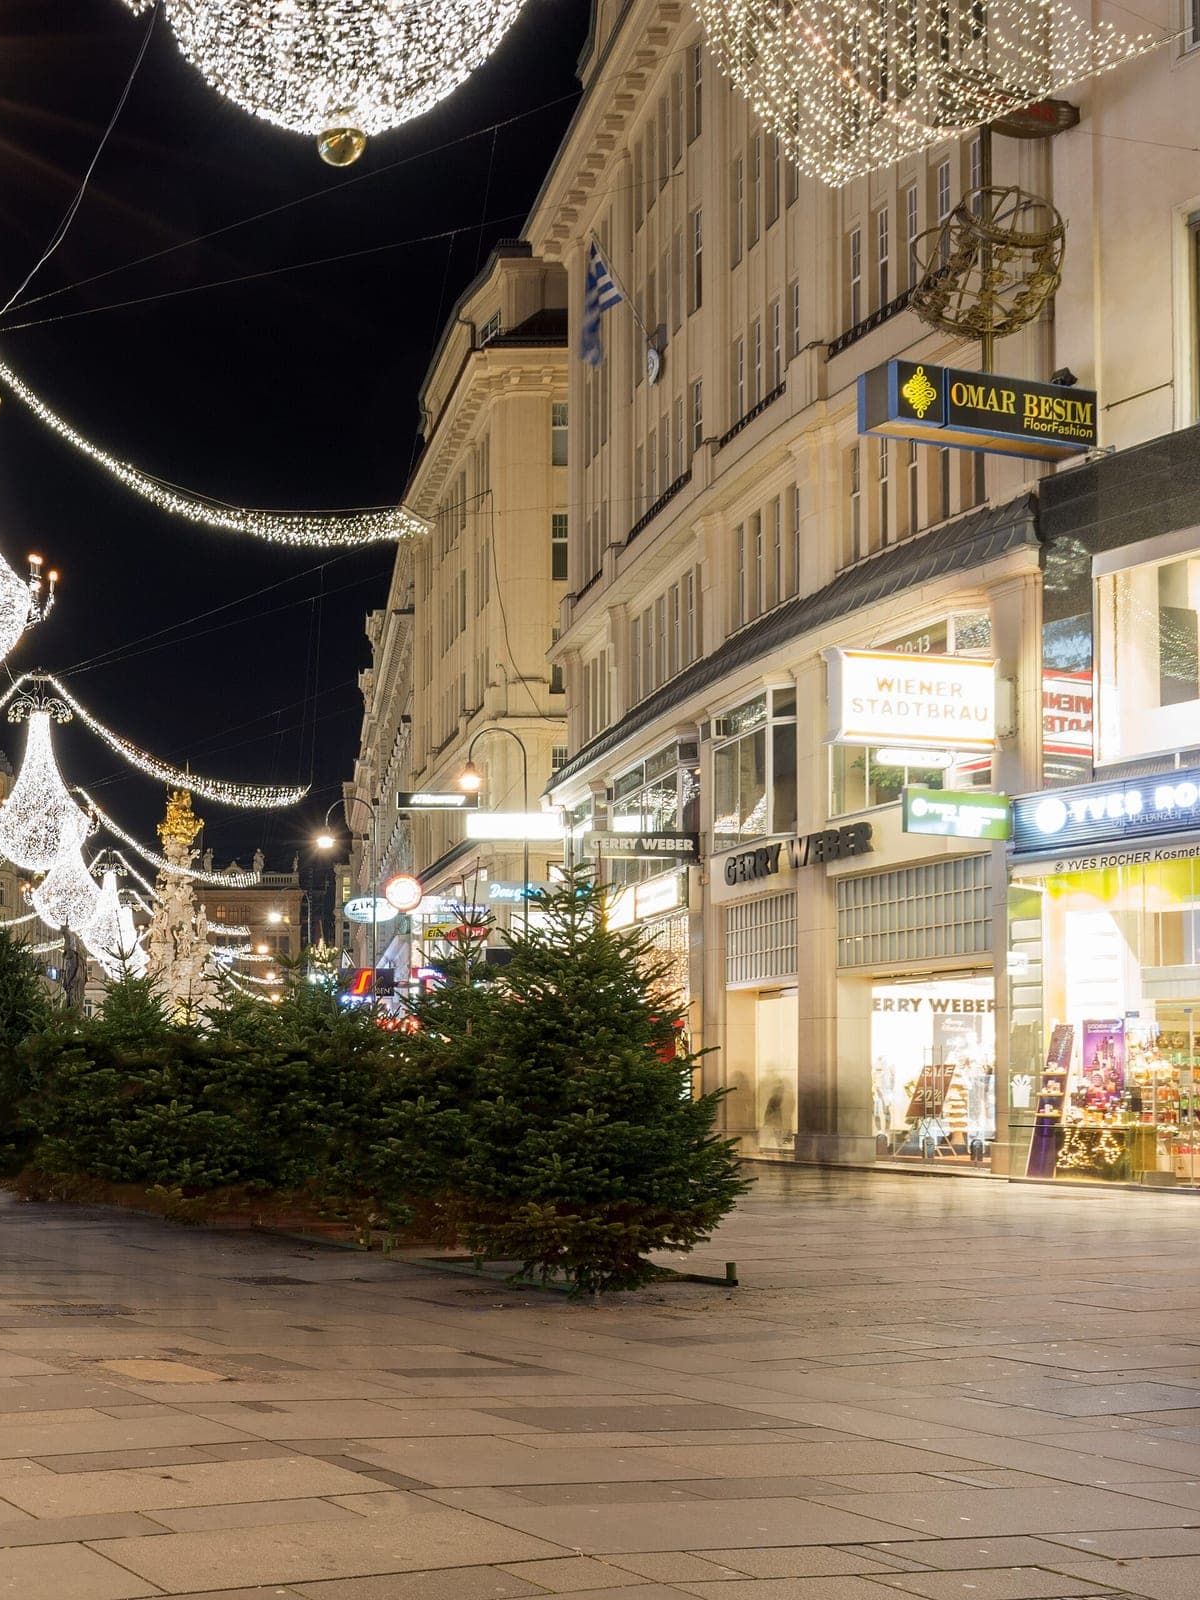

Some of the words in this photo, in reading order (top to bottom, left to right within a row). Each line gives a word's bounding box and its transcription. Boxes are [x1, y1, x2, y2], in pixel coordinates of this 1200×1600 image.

[951, 382, 1016, 415] OMAR
[1023, 393, 1094, 425] BESIM
[1024, 417, 1094, 438] FloorFashion
[876, 676, 963, 697] WIENER
[1069, 788, 1143, 822] YVES
[1154, 782, 1200, 811] RO
[590, 838, 639, 849] GERRY
[641, 838, 694, 851] WEBER
[723, 842, 783, 887] GERRY
[786, 821, 874, 870] WEBER
[1068, 858, 1097, 871] YVES
[1100, 851, 1151, 867] ROCHER
[872, 998, 923, 1013] ERRY
[922, 1065, 955, 1077] SALE
[915, 1089, 944, 1102] 20%
